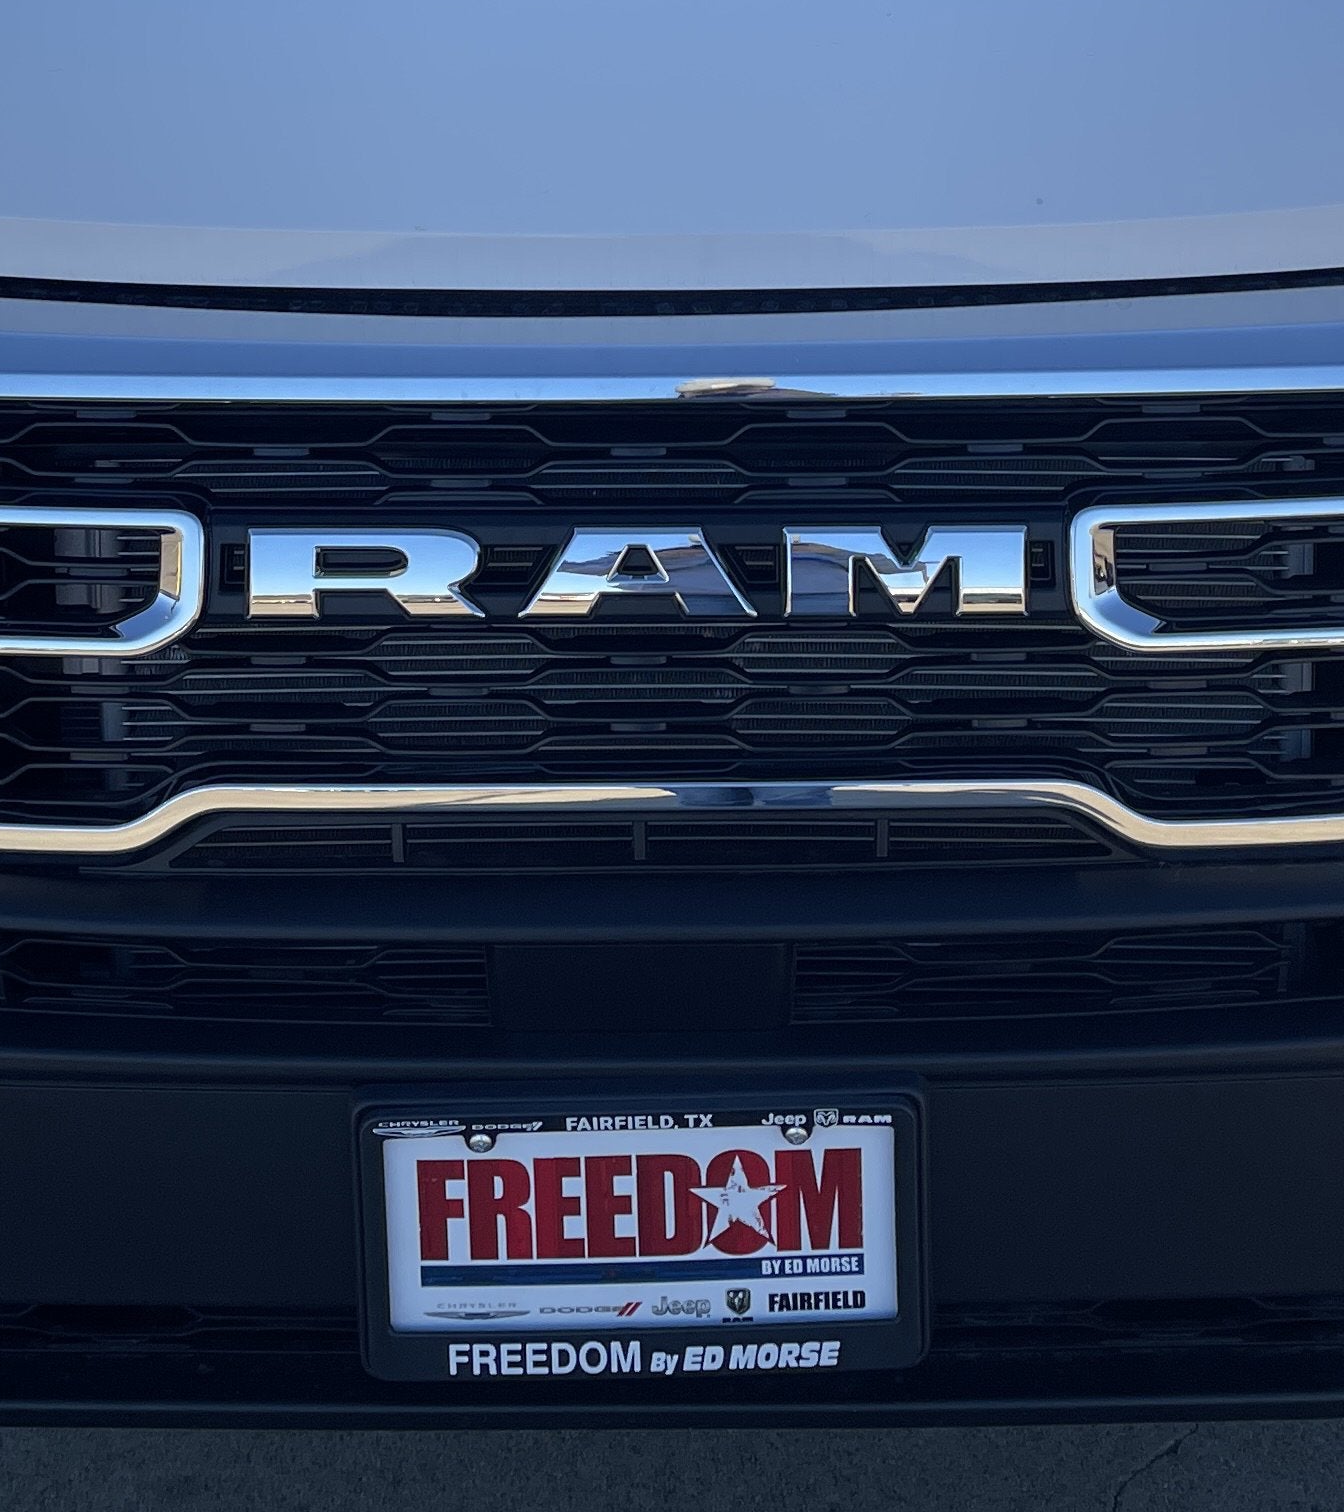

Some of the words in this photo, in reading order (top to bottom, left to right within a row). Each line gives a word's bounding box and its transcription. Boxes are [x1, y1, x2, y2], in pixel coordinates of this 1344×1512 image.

[247, 524, 1029, 619] RAM
[378, 1119, 460, 1128] CHRYSLER
[565, 1115, 679, 1131] FAIRFIELD,
[684, 1114, 713, 1128] TX
[761, 1113, 807, 1126] Jeep
[842, 1114, 893, 1124] RAM
[416, 1146, 864, 1262] FREEDOM
[761, 1259, 783, 1276] BY
[784, 1259, 805, 1275] ED
[807, 1256, 859, 1274] MORSE
[436, 1301, 518, 1310] CHRYSLER
[539, 1305, 620, 1315] DODGE
[651, 1295, 712, 1318] Jeep
[768, 1289, 866, 1313] FAIRFIELD
[447, 1340, 641, 1376] FREEDOM
[650, 1351, 679, 1376] By
[683, 1345, 726, 1372] ED
[729, 1340, 841, 1370] MORSE
